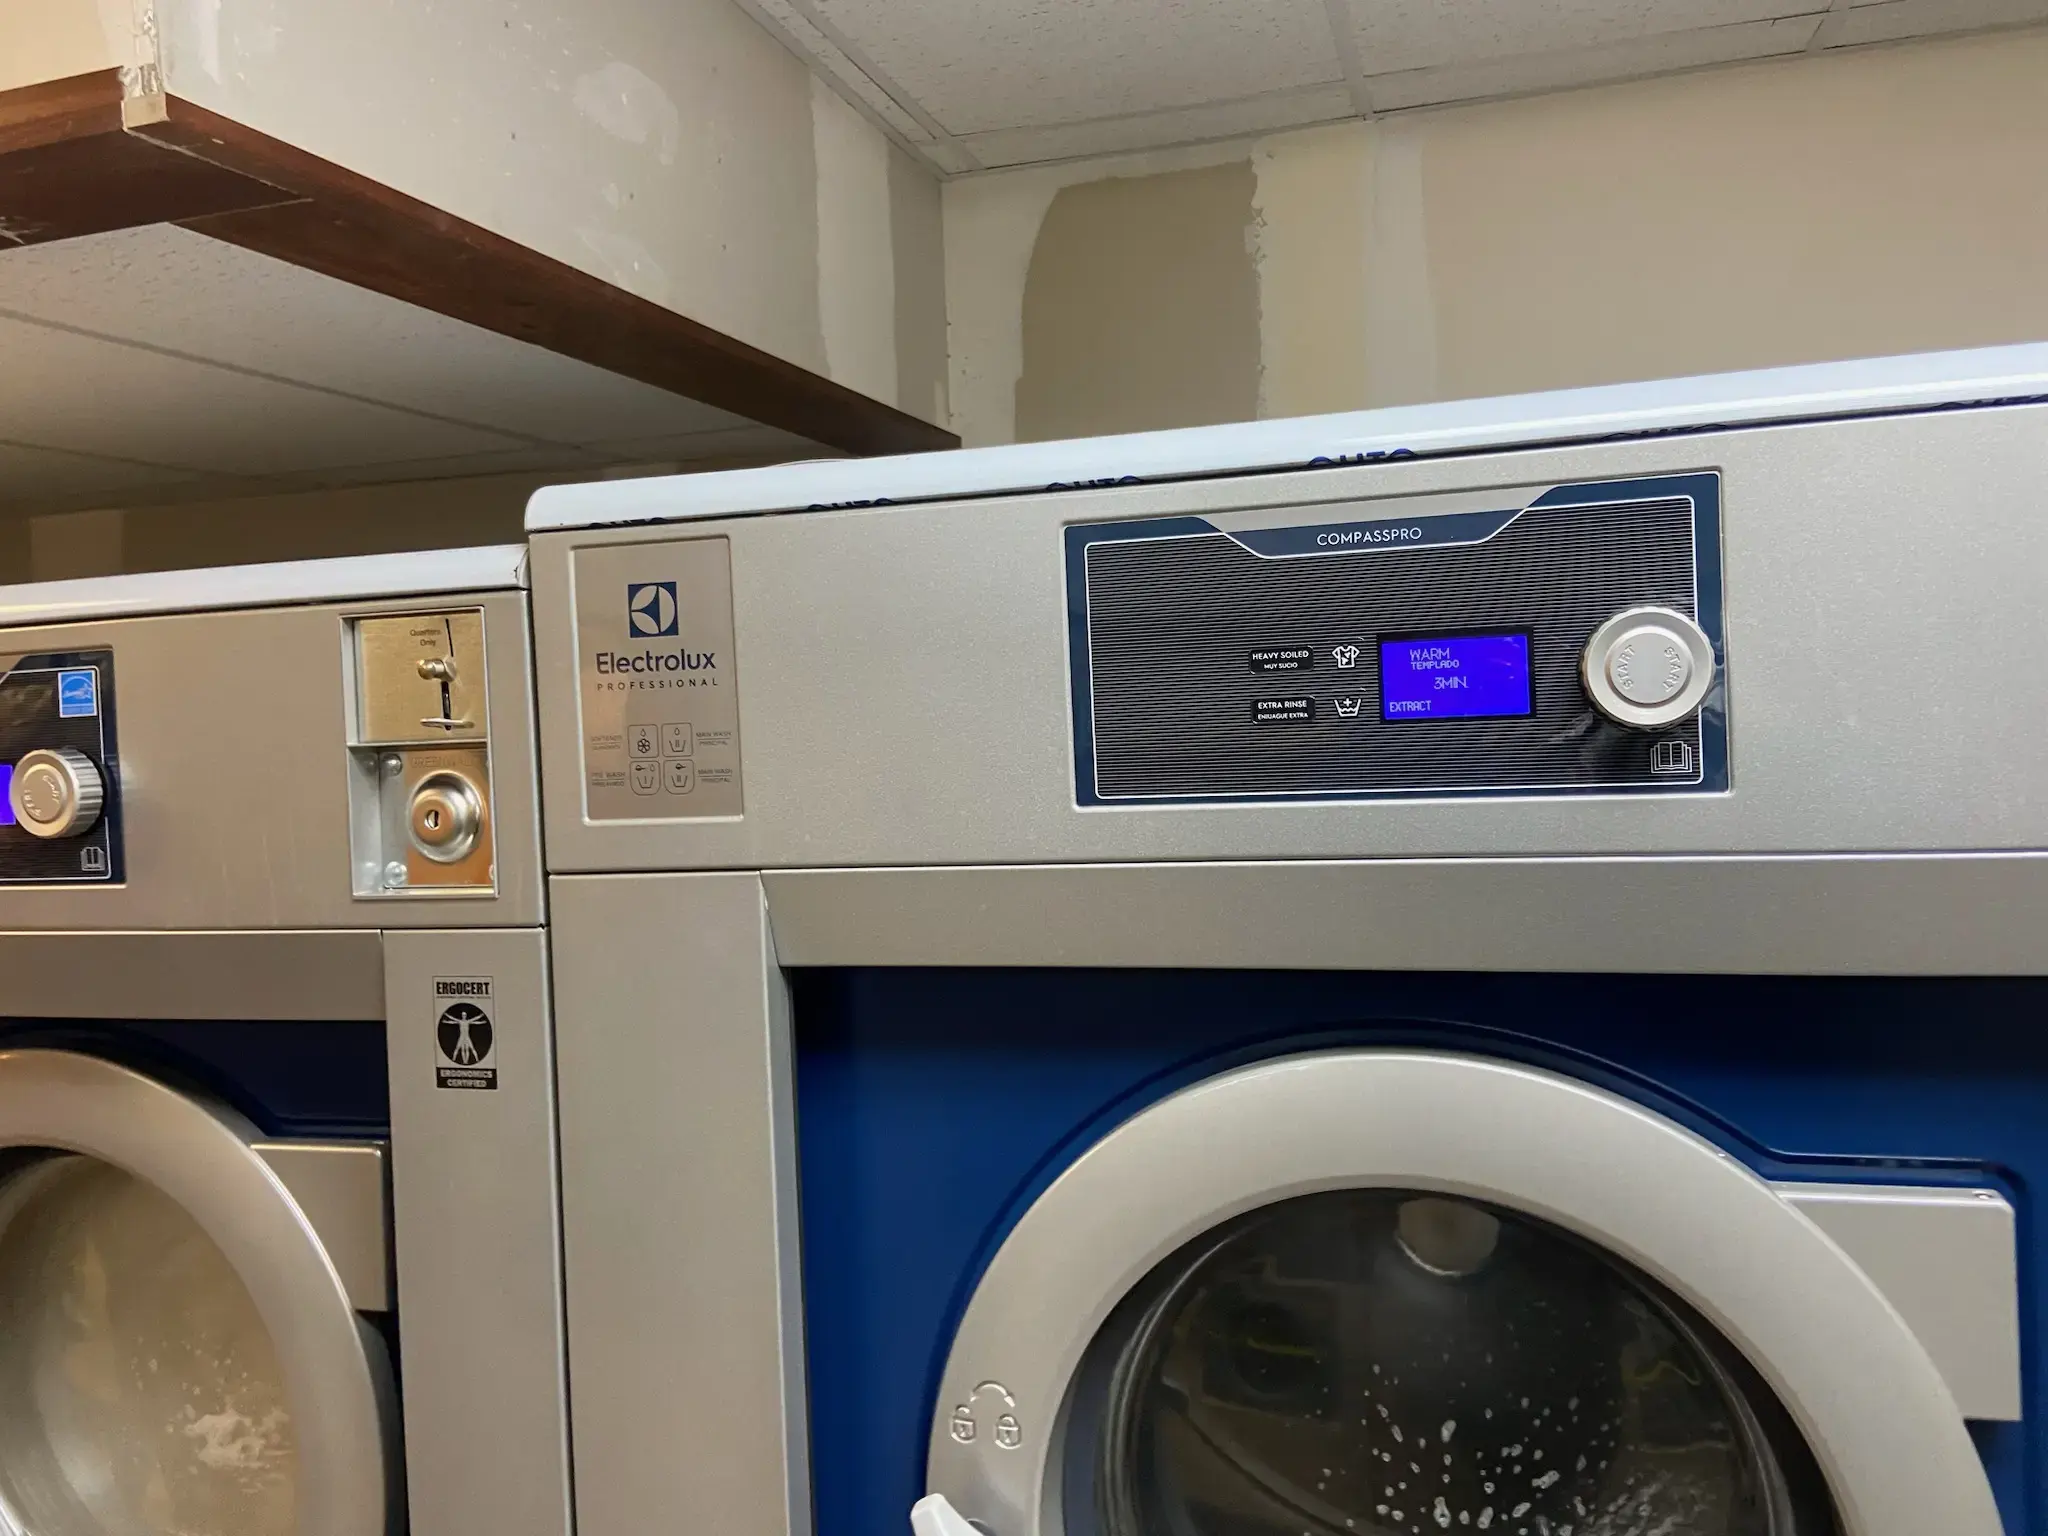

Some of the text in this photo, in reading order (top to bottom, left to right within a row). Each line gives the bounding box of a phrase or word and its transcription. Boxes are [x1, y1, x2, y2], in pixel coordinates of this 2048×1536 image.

[1316, 527, 1422, 546] COMPASSPRO
[1252, 650, 1309, 660] HEAVY SOILED
[1409, 648, 1450, 661] WARM
[596, 649, 716, 675] Electrolux
[1411, 660, 1460, 670] TEMPLADO
[597, 678, 718, 691] PROFESSIONAL
[1258, 700, 1307, 709] EXTRA RINSE
[1389, 700, 1432, 713] EXTRACT
[436, 982, 490, 995] ERGOCERT
